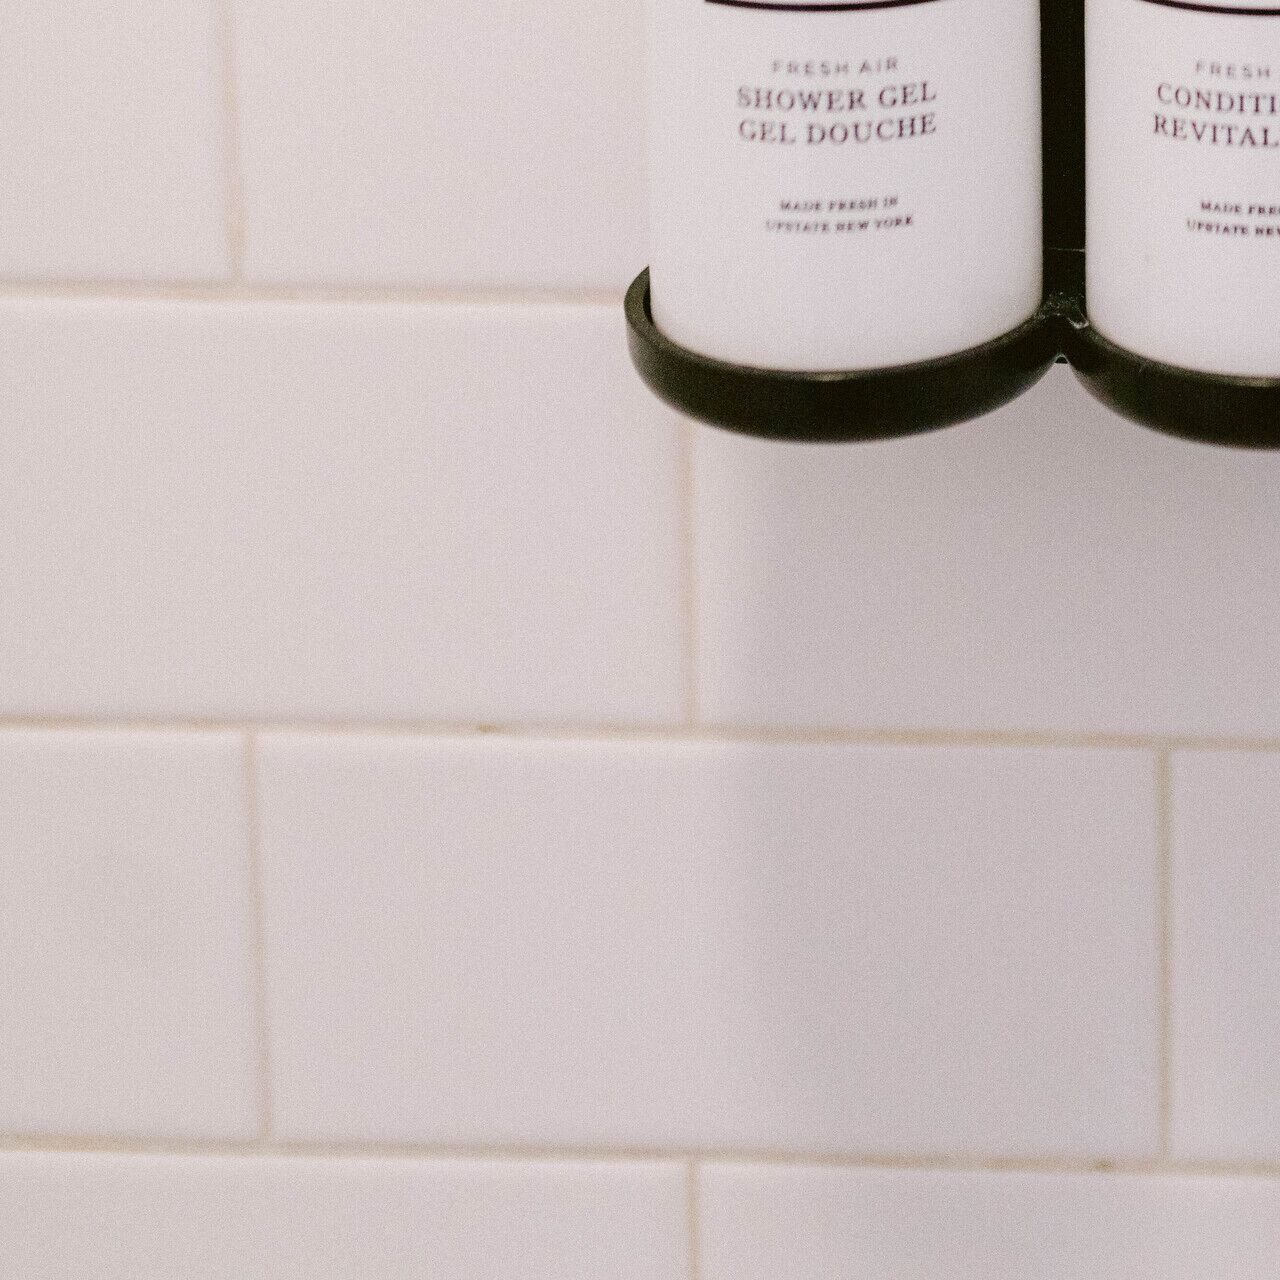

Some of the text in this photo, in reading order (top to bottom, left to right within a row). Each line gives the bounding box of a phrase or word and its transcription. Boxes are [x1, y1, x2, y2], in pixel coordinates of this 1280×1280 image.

[773, 57, 898, 76] FRESH AIR
[1195, 61, 1271, 79] FRESH
[737, 80, 937, 113] SHOWER GEL
[739, 113, 937, 145] GEL DOUCHE
[779, 195, 900, 212] MADE FRESH IN
[1199, 200, 1244, 216] MADE
[765, 214, 915, 234] UPSTATE NEW YORK
[1186, 219, 1250, 237] UPSTATE
